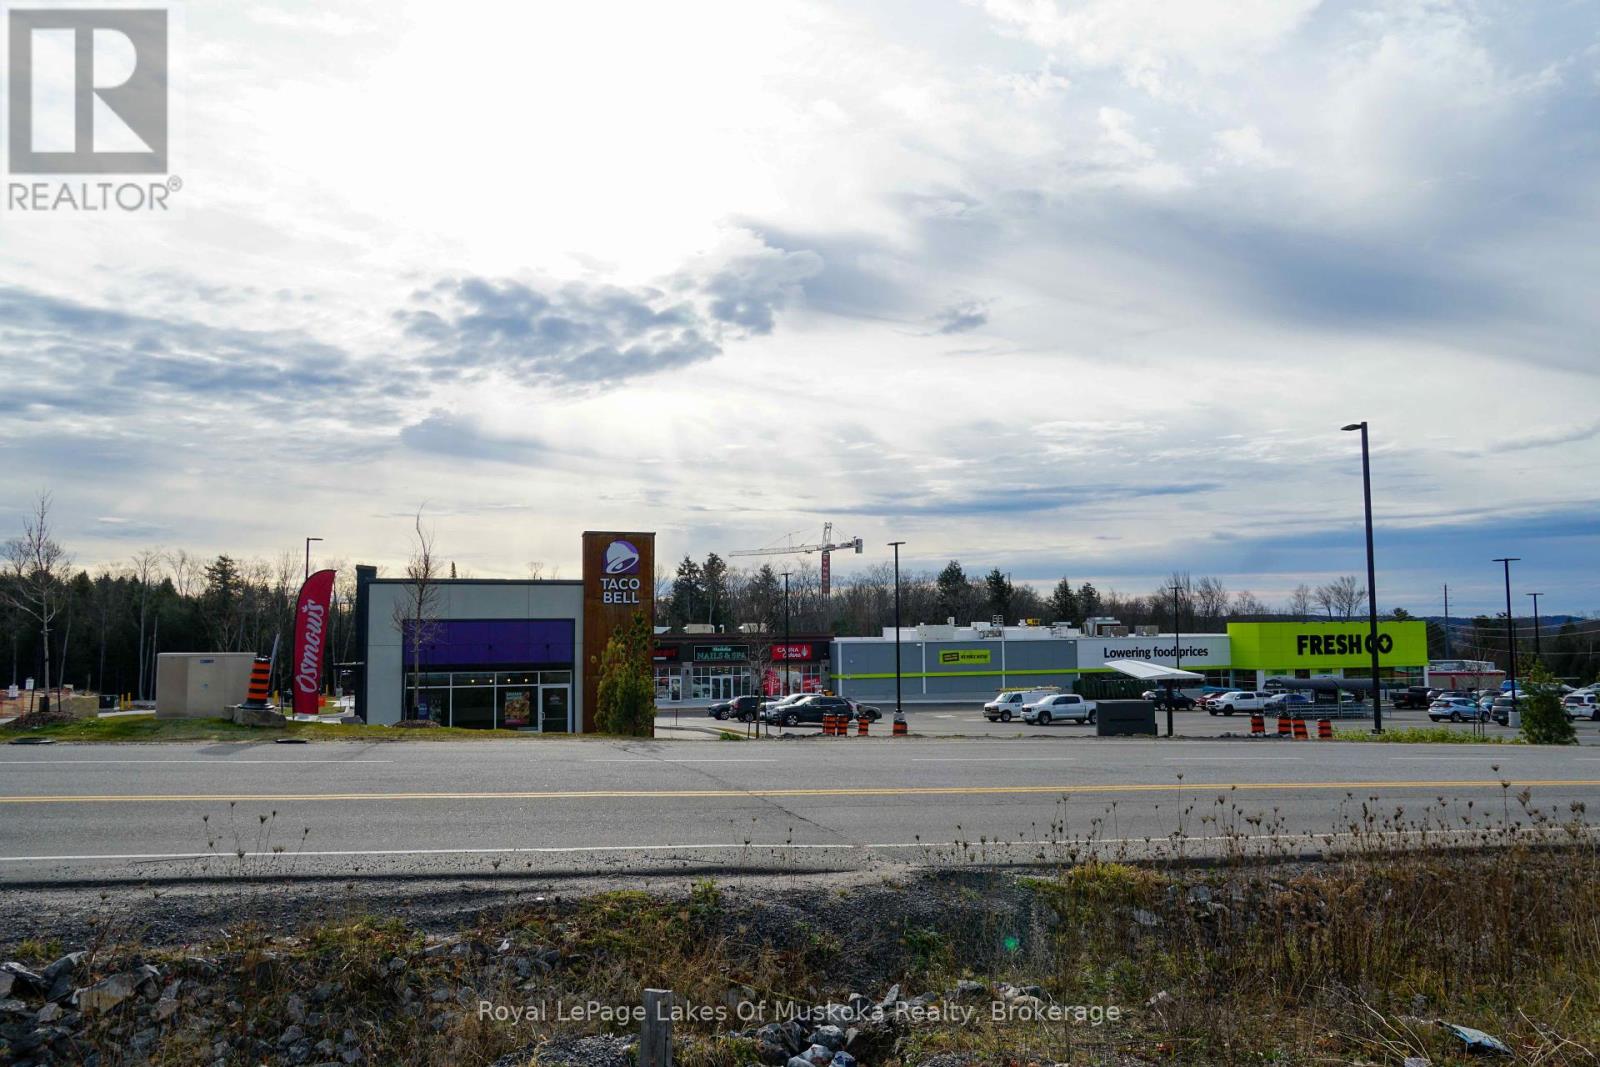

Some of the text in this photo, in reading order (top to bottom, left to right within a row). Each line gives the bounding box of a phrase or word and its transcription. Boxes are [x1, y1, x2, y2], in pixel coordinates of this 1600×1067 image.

[600, 578, 640, 590] TACO
[603, 591, 640, 603] BELL
[697, 652, 724, 660] NAILS
[731, 652, 747, 660] SPA
[1104, 645, 1209, 659] Lowering food prices
